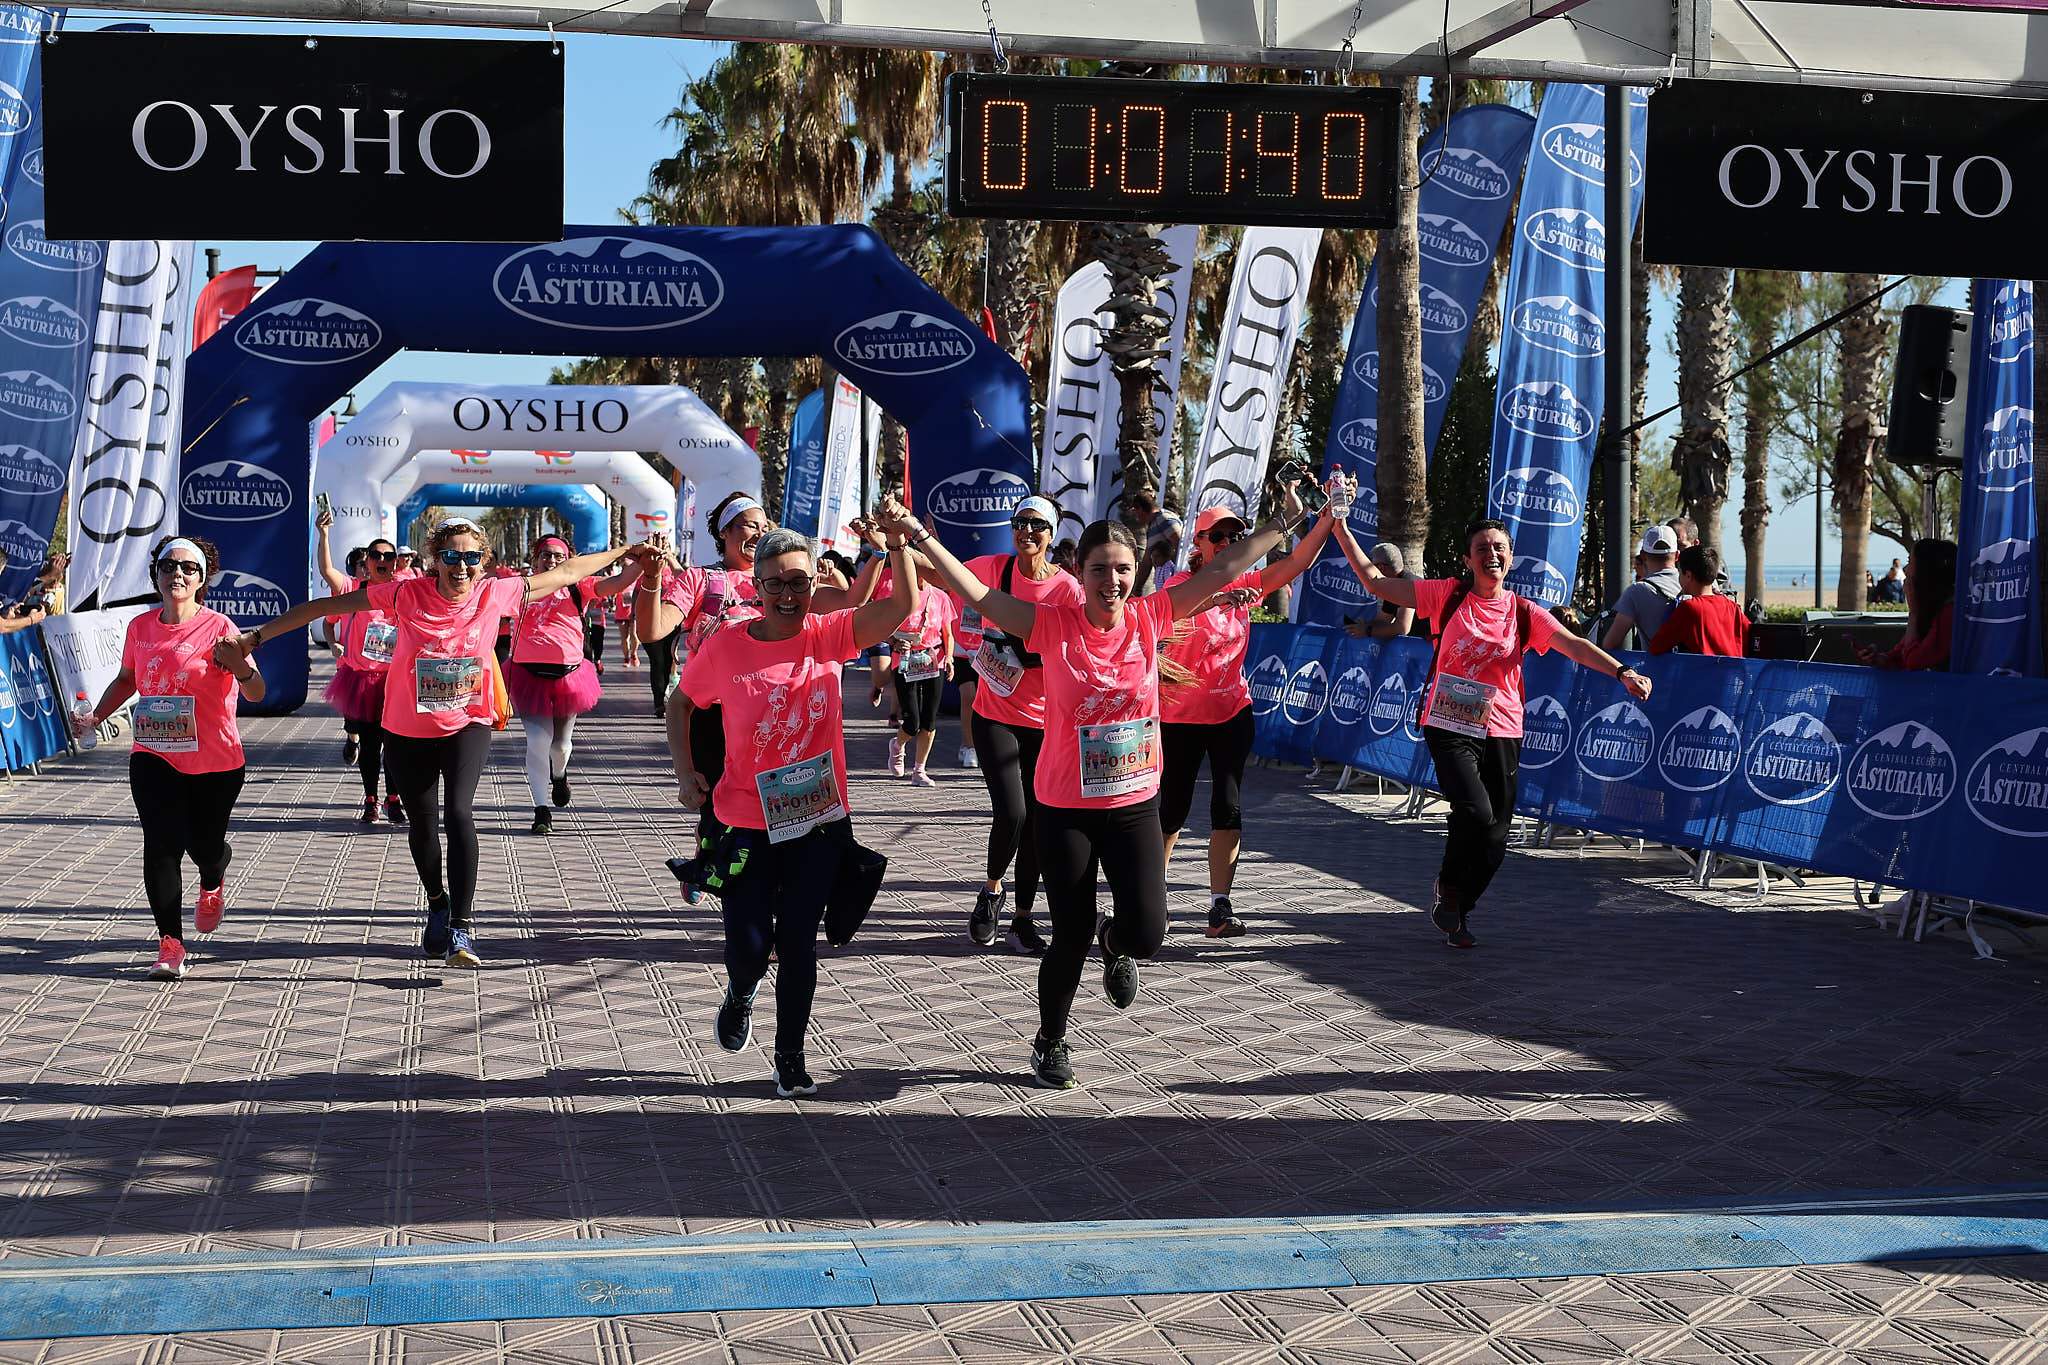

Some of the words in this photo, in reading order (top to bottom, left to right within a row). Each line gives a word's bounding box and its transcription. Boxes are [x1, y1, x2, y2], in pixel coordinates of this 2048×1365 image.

[132, 100, 492, 178] OYSHO
[983, 100, 1366, 200] 01:01:40
[1427, 155, 1501, 195] ASTURIANA
[1718, 144, 2013, 218] OYSHO
[12, 229, 94, 264] ASTURIANA
[547, 262, 619, 275] CENTRAL
[627, 265, 700, 276] LECHERA
[511, 263, 708, 308] ASTURIANA
[1, 306, 81, 342] ASTURIANA
[243, 321, 371, 350] ASTURIANA
[846, 335, 969, 360] ASTURIANA
[0, 389, 68, 415] STURIANA
[453, 397, 629, 434] OYSHO
[346, 434, 400, 448] OYSHO
[678, 437, 731, 450] OYSHO
[185, 482, 285, 507] ASTURIANA
[332, 506, 372, 518] YSHO
[732, 671, 768, 683] OYSHO
[1522, 730, 1564, 754] TURIANA
[1578, 727, 1647, 765] ASTURIANA
[1662, 734, 1733, 772] ASTURIANA
[1109, 752, 1137, 768] 016
[1749, 741, 1832, 785] ASTURIANA
[1851, 753, 1945, 798] ASTURIANA
[790, 791, 820, 809] 016
